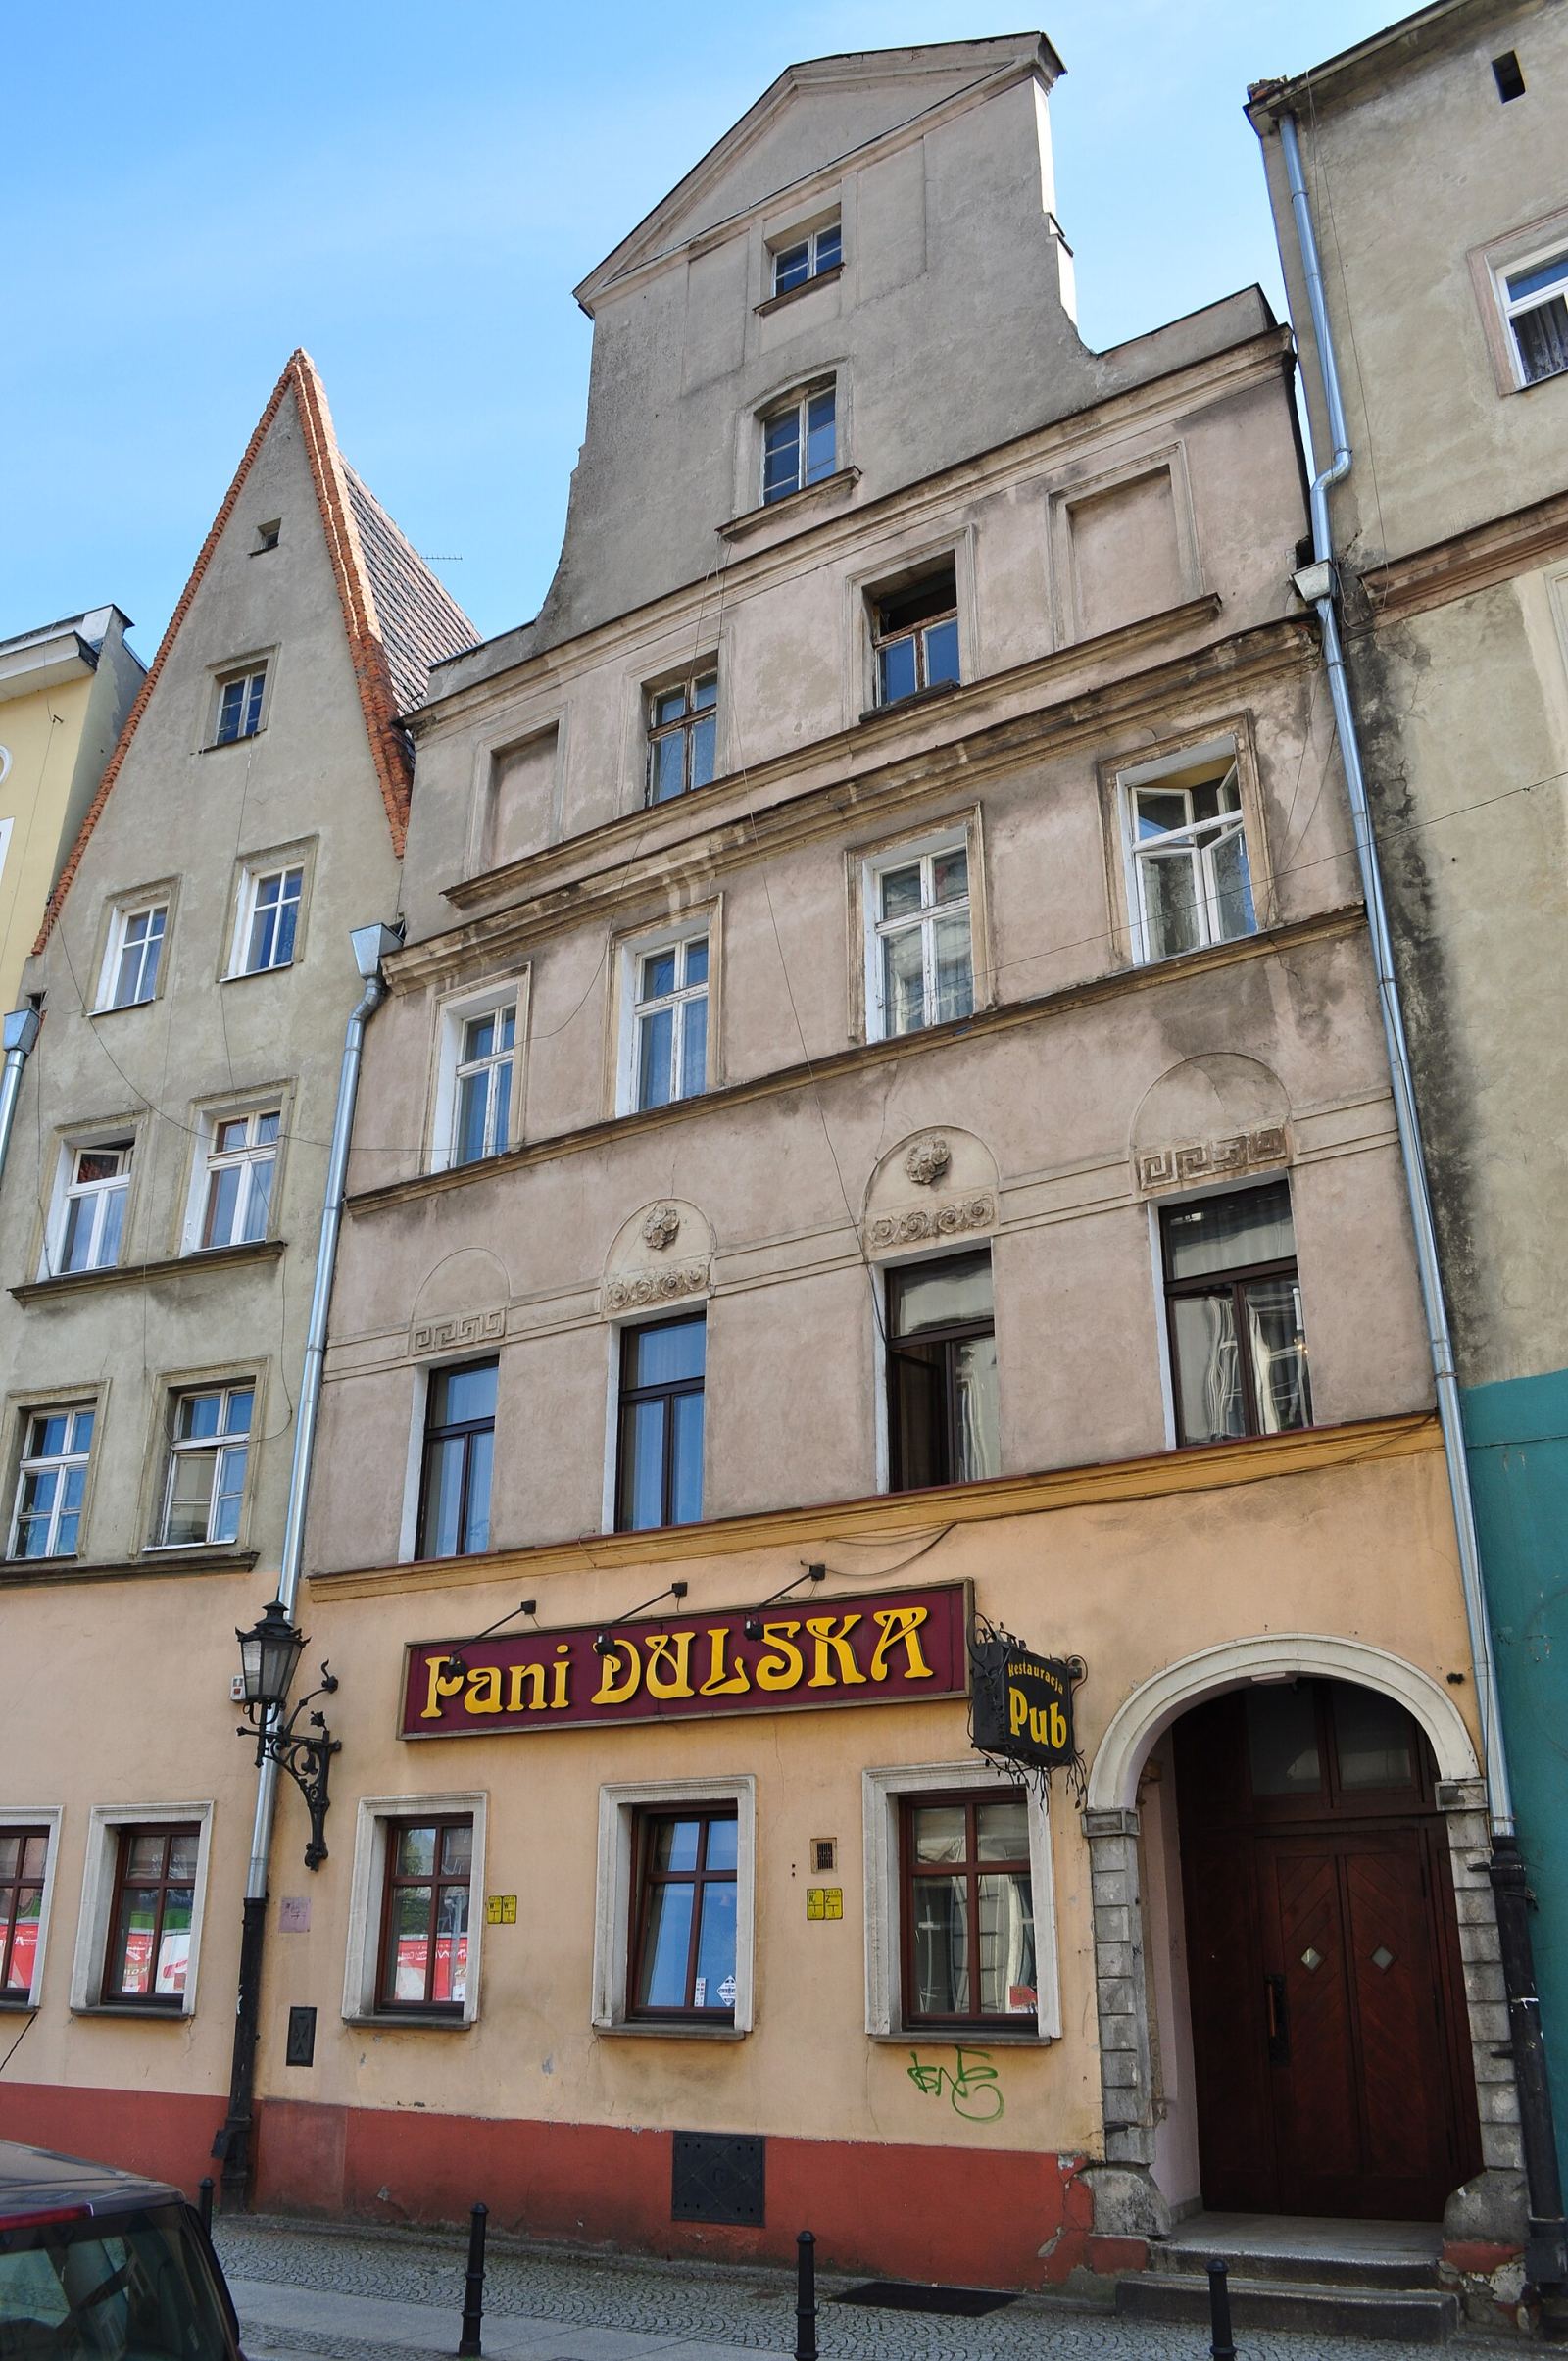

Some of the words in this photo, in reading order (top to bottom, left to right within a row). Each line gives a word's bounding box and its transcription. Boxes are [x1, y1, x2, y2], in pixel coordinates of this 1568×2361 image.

[420, 1645, 570, 1718] Pani
[591, 1607, 933, 1704] DULSKA
[1008, 1662, 1063, 1695] Restauracja
[1009, 1686, 1067, 1749] Pub
